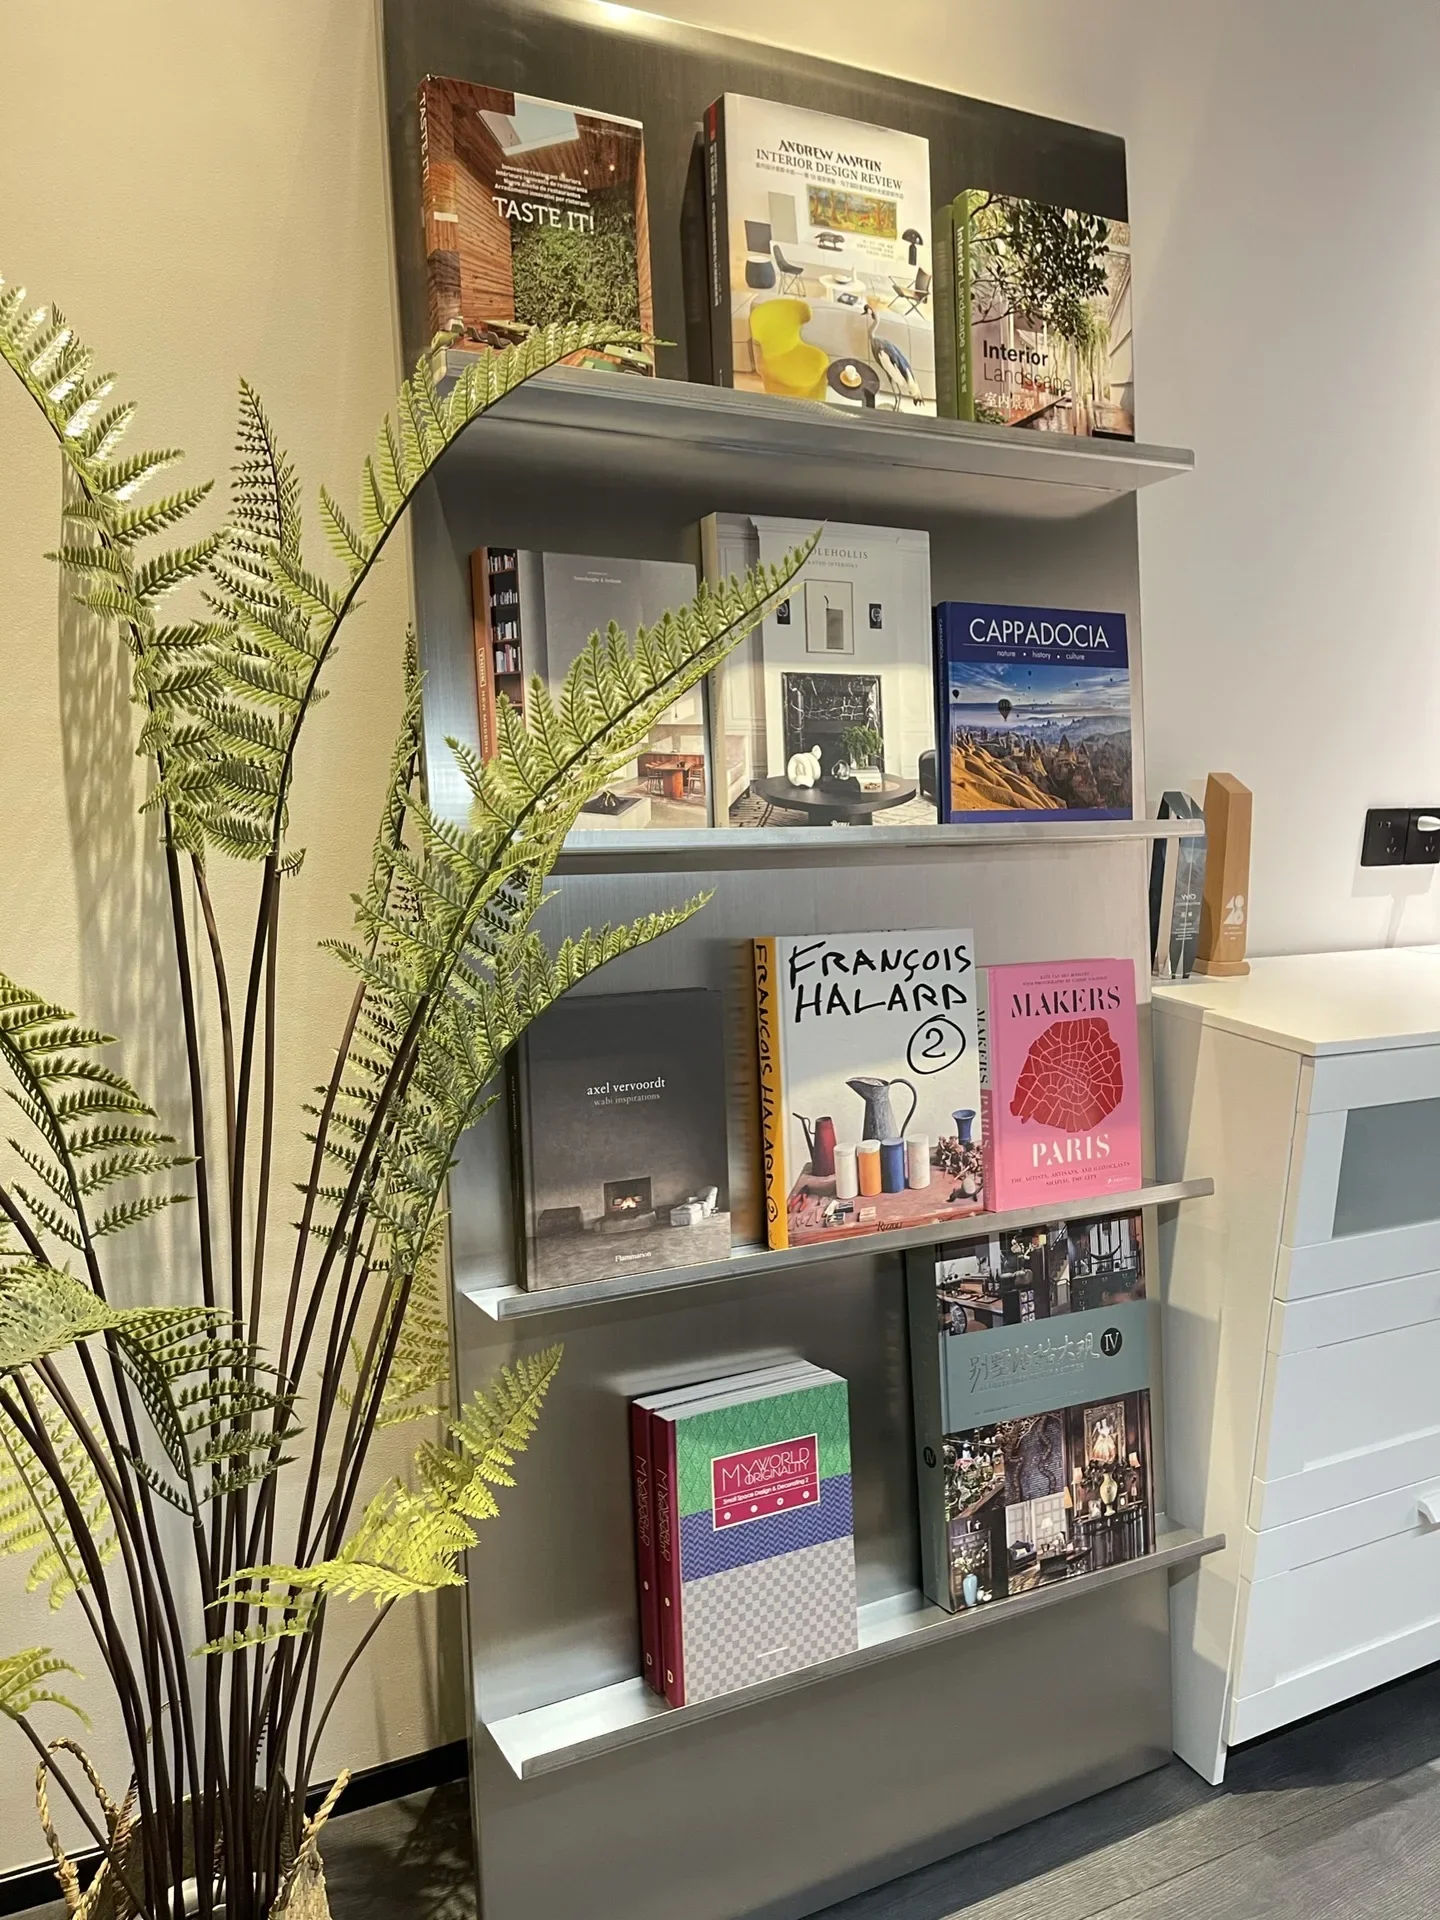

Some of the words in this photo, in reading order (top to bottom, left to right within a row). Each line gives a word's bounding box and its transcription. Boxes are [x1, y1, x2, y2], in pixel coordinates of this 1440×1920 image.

[756, 149, 814, 171] INTERIOR
[815, 162, 859, 181] DESIGN
[860, 173, 903, 190] REVIEW
[778, 140, 834, 161] ANDREW
[835, 152, 882, 172] MARTIN
[492, 196, 562, 229] TASTE
[567, 210, 595, 235] IT!
[957, 226, 965, 277] Interior
[958, 278, 967, 348] Landscape
[983, 340, 1049, 367] Interior
[983, 362, 1072, 393] Landscape
[984, 391, 1036, 412] 室内景观
[969, 618, 1110, 649] CAPPADOCIA
[997, 650, 1017, 658] nature
[1032, 650, 1051, 660] history
[1065, 652, 1086, 661] culture
[788, 940, 972, 991] FRANÇOIS
[795, 982, 968, 1024] HALARD
[1012, 985, 1121, 1018] MAKERS
[921, 1027, 947, 1058] 2
[977, 1007, 988, 1084] MAKERS
[586, 1081, 610, 1096] axel
[612, 1076, 666, 1092] vervoordt
[593, 1096, 613, 1106] wabi
[615, 1093, 661, 1105] inspirations
[1032, 1133, 1110, 1168] PARIS
[1104, 1331, 1120, 1352] IV
[744, 1459, 809, 1485] ORIGINALITY
[722, 1495, 737, 1505] Small
[738, 1492, 754, 1501] Space
[754, 1486, 772, 1497] Design
[776, 1478, 805, 1491] Decorating
